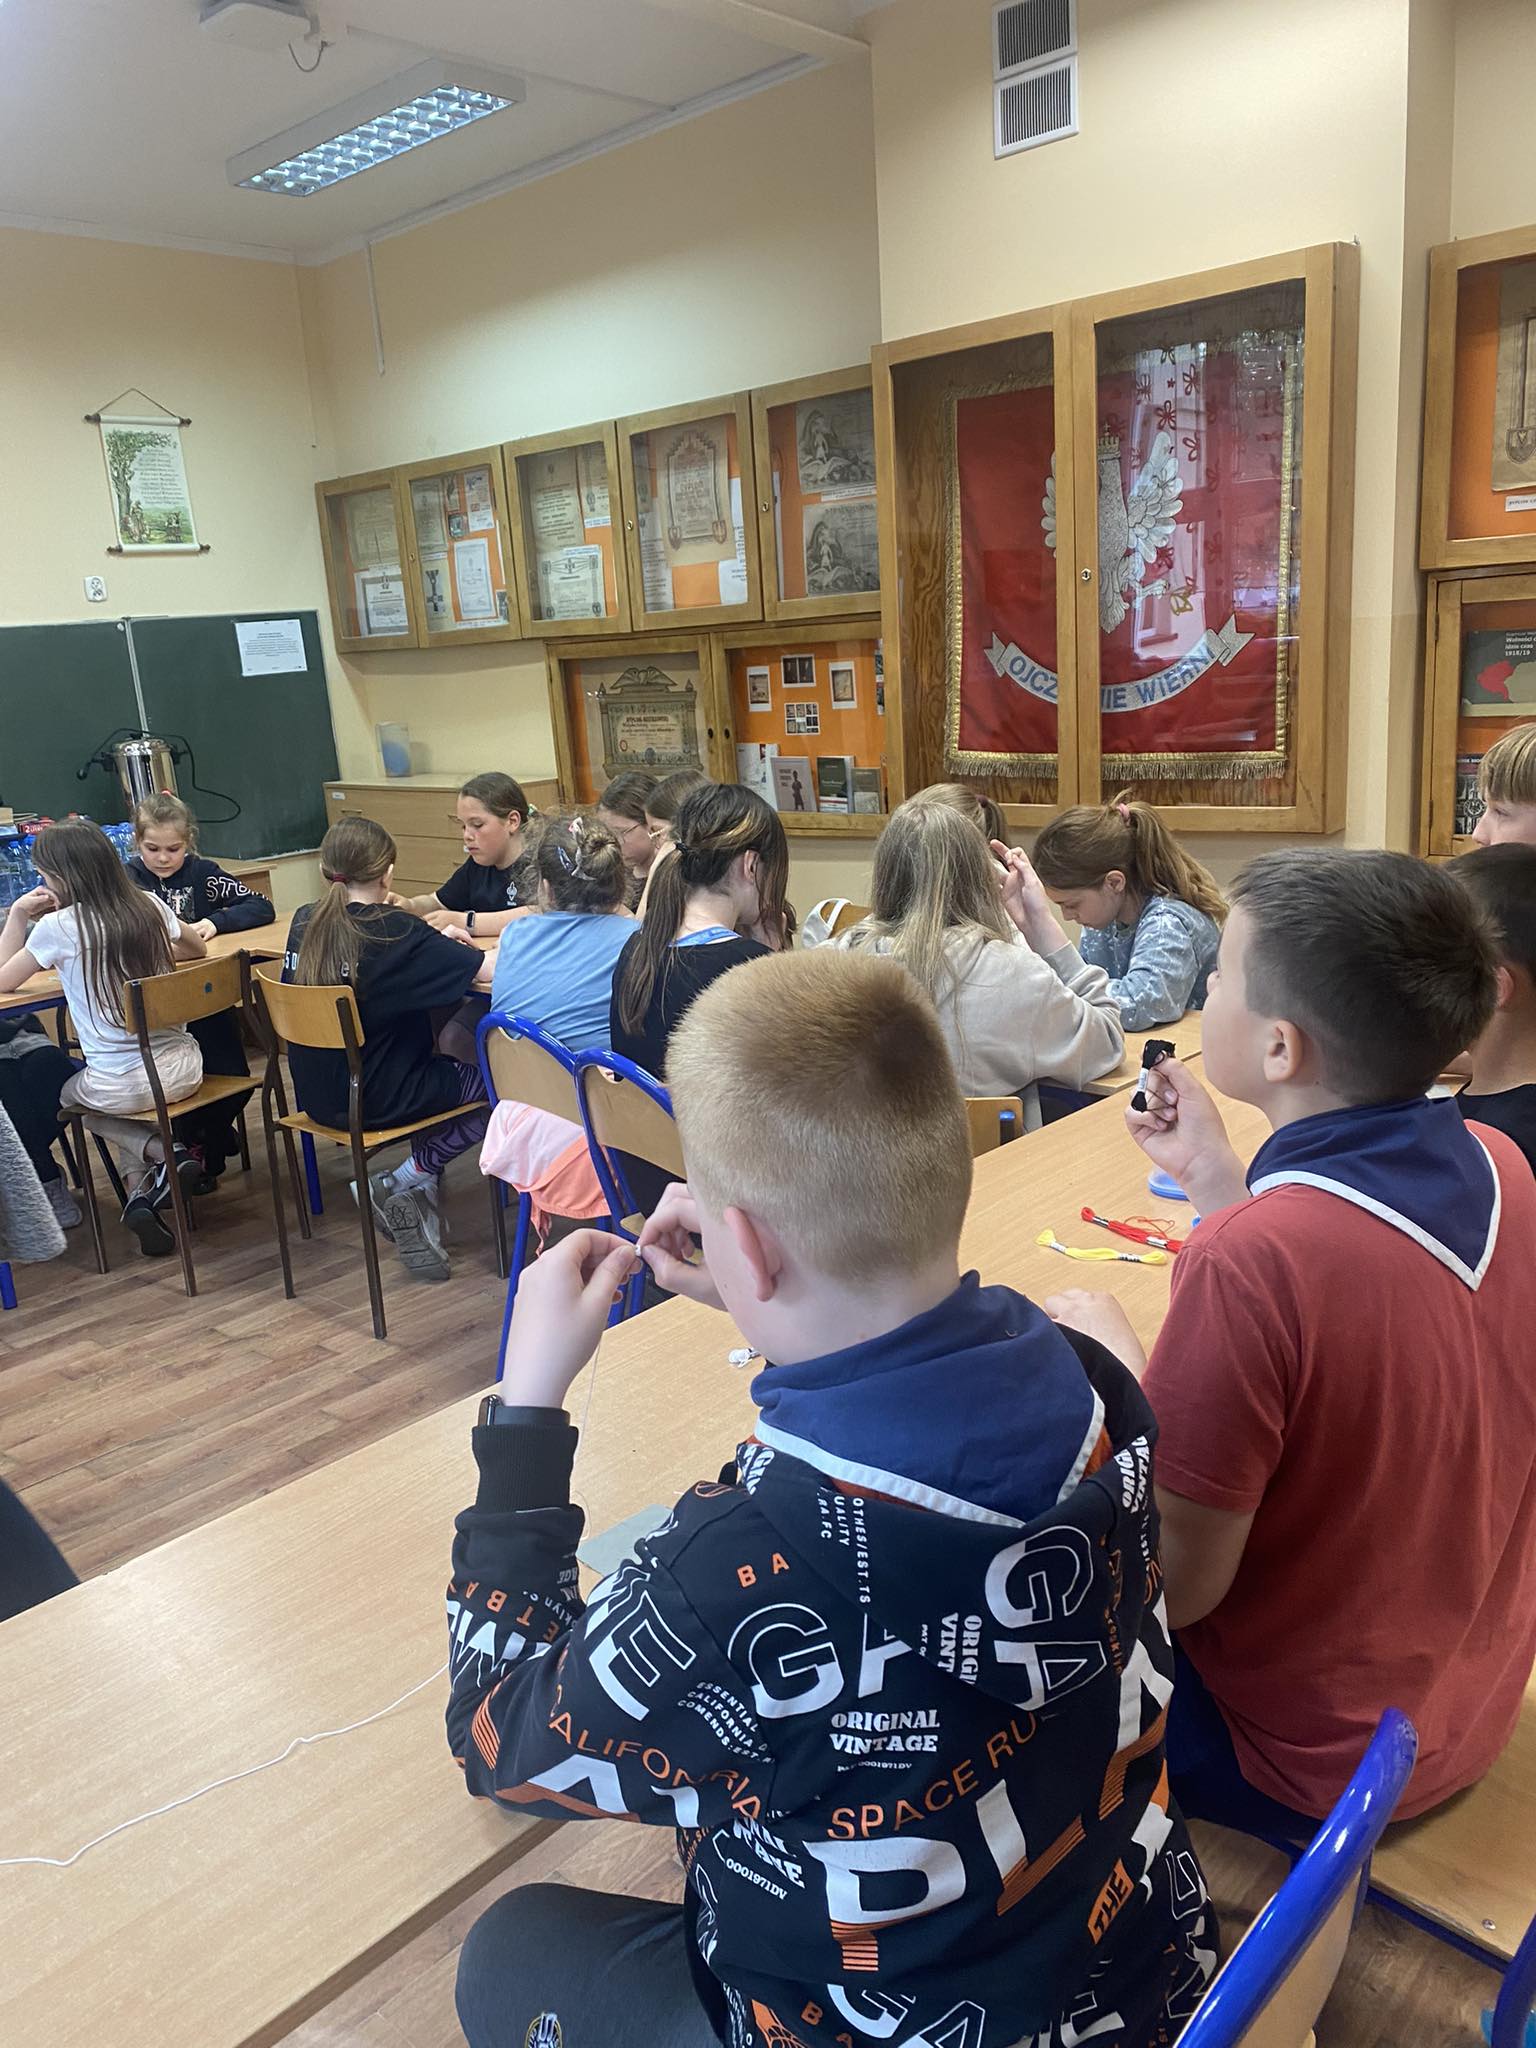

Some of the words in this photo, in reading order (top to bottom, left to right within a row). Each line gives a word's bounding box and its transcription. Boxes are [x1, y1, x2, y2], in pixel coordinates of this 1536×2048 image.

[687, 1690, 754, 1748] CALIFORNIA
[696, 1681, 759, 1732] ESSENTIAL
[831, 1709, 941, 1732] ORIGINAL
[829, 1733, 939, 1755] VINTAGE
[827, 1759, 980, 1841] SPACE
[726, 1858, 788, 1900] 0001971DV
